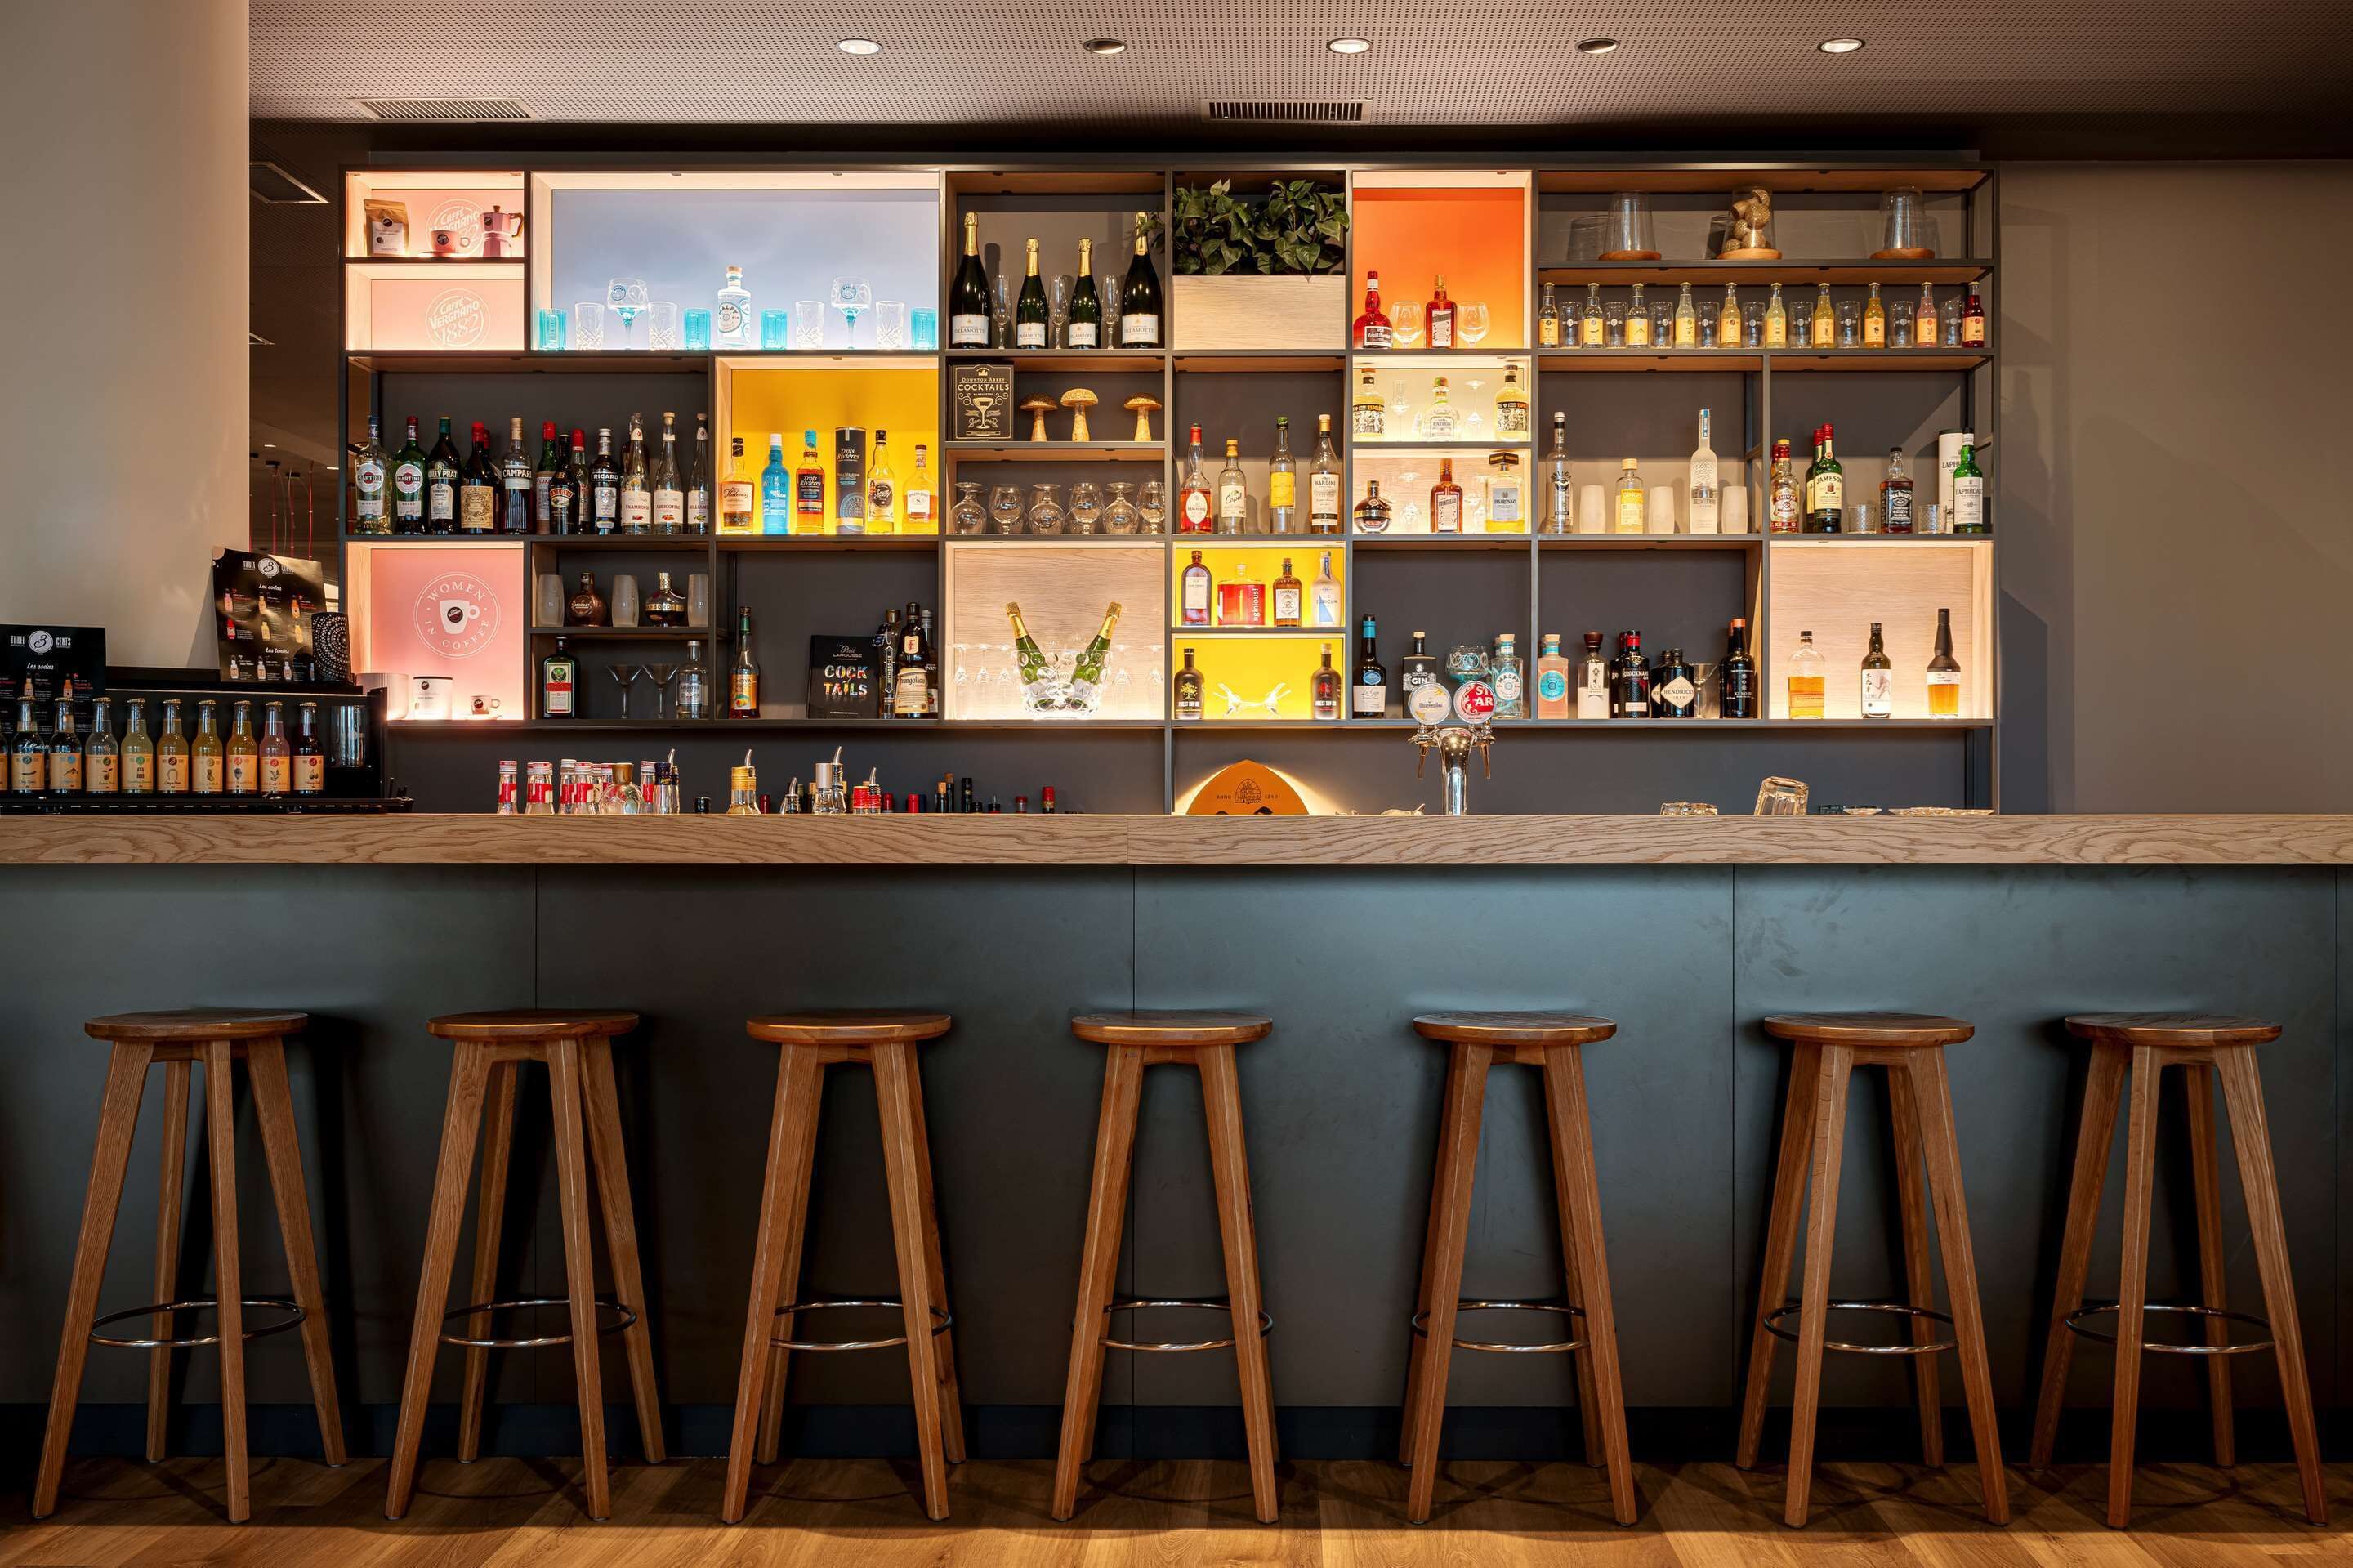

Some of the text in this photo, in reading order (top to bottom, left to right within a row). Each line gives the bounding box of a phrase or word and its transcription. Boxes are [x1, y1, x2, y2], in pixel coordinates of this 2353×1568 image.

[442, 313, 480, 345] 1882
[502, 469, 532, 478] CAMPARI
[1816, 476, 1842, 484] JAMESON
[427, 581, 486, 602] WOMEN
[425, 620, 437, 636] IN
[56, 637, 71, 646] CENTS
[442, 620, 489, 650] COFFEE
[824, 665, 868, 679] COCK
[1498, 674, 1520, 683] MALFY
[824, 682, 868, 695] TAILS
